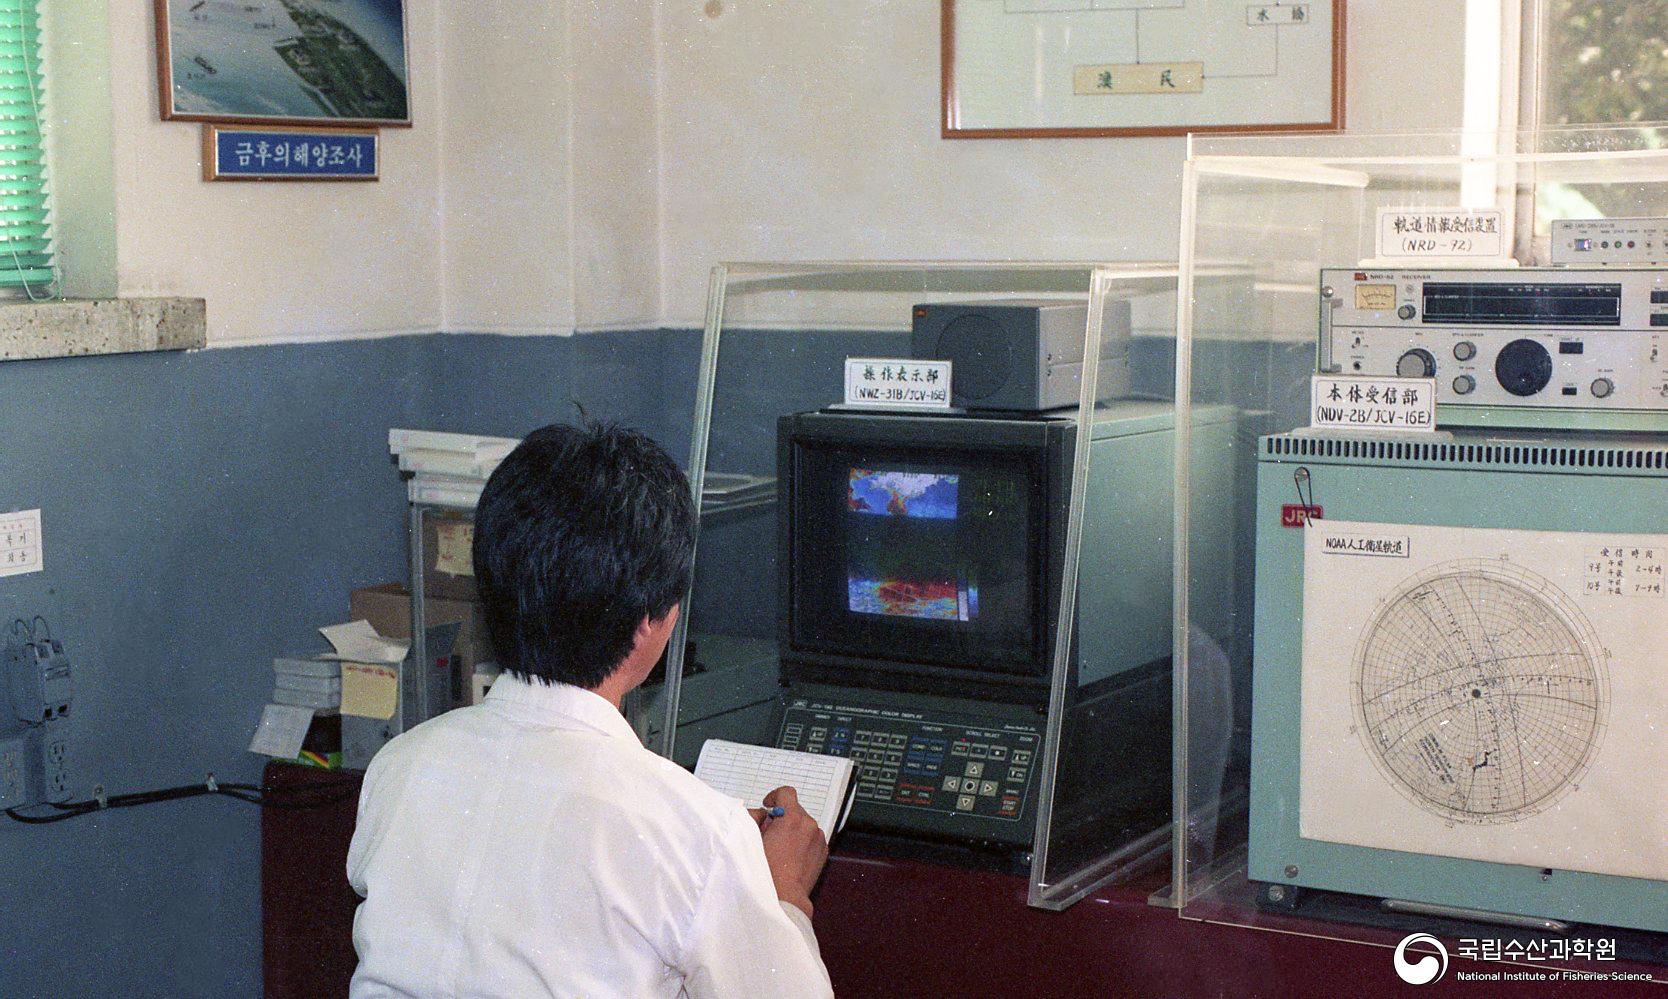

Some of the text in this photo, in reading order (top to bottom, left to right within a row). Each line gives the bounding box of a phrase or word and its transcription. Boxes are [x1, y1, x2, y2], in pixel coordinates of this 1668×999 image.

[1327, 383, 1418, 406] 本体受信部
[1316, 405, 1432, 425] (NDV-2B/JCV-16E)
